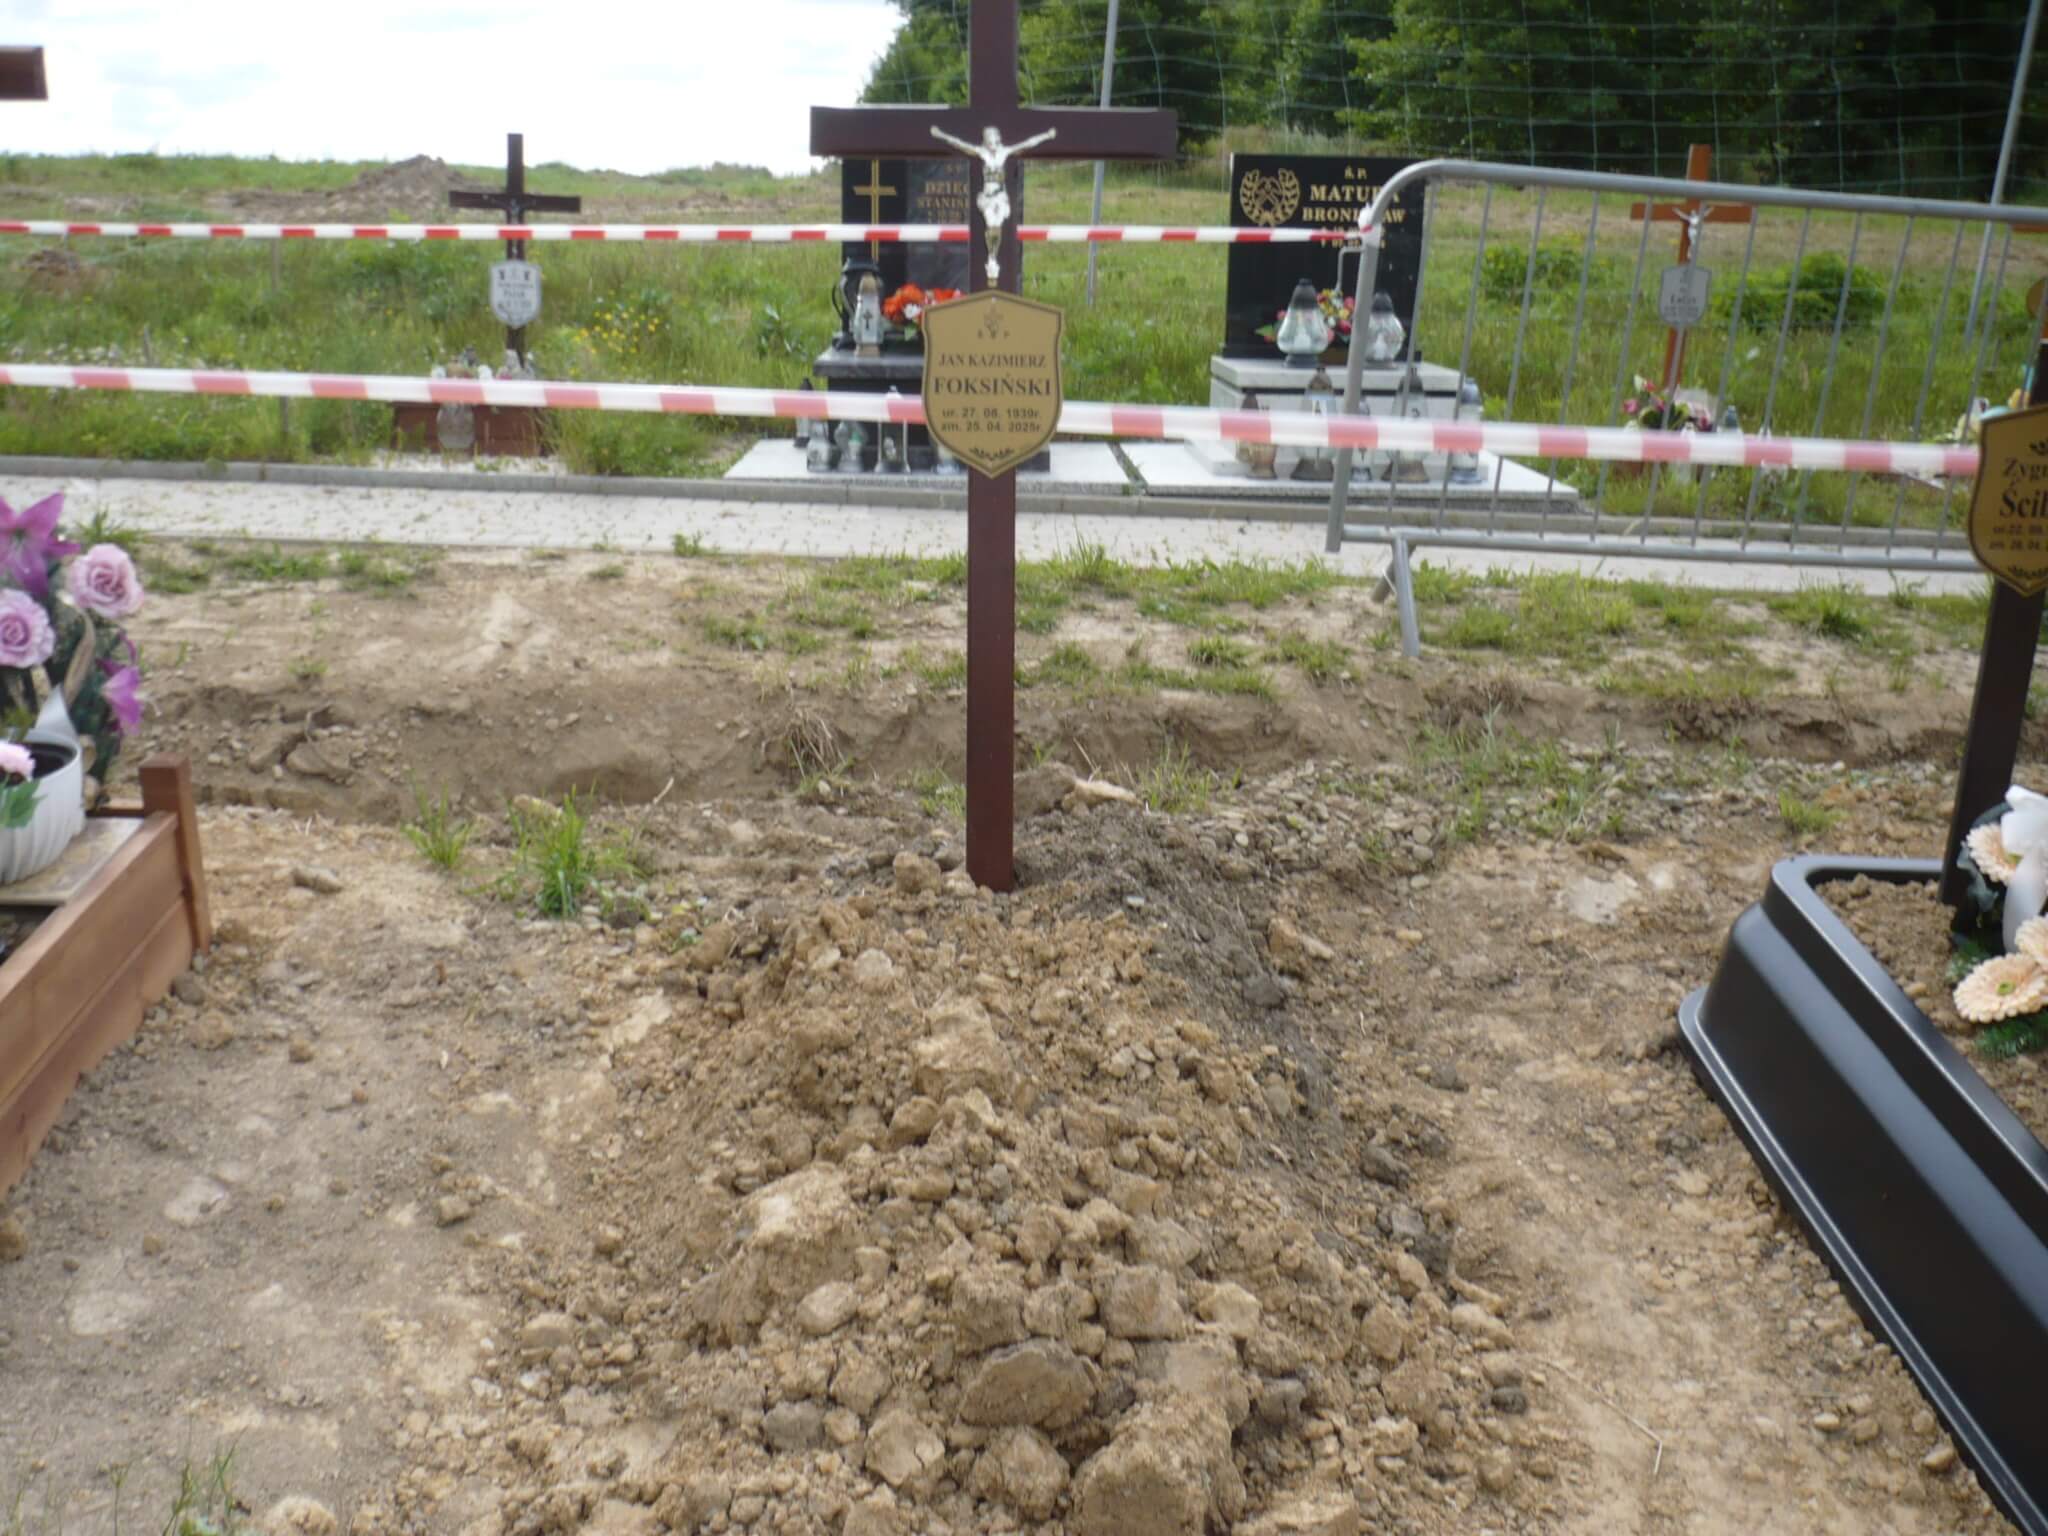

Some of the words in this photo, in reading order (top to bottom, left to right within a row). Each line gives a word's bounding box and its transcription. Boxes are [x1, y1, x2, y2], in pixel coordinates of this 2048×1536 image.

[938, 354, 965, 368] JAN
[968, 354, 1046, 369] KAZIMIERZ
[934, 372, 1051, 396] FOKSIŃSKI
